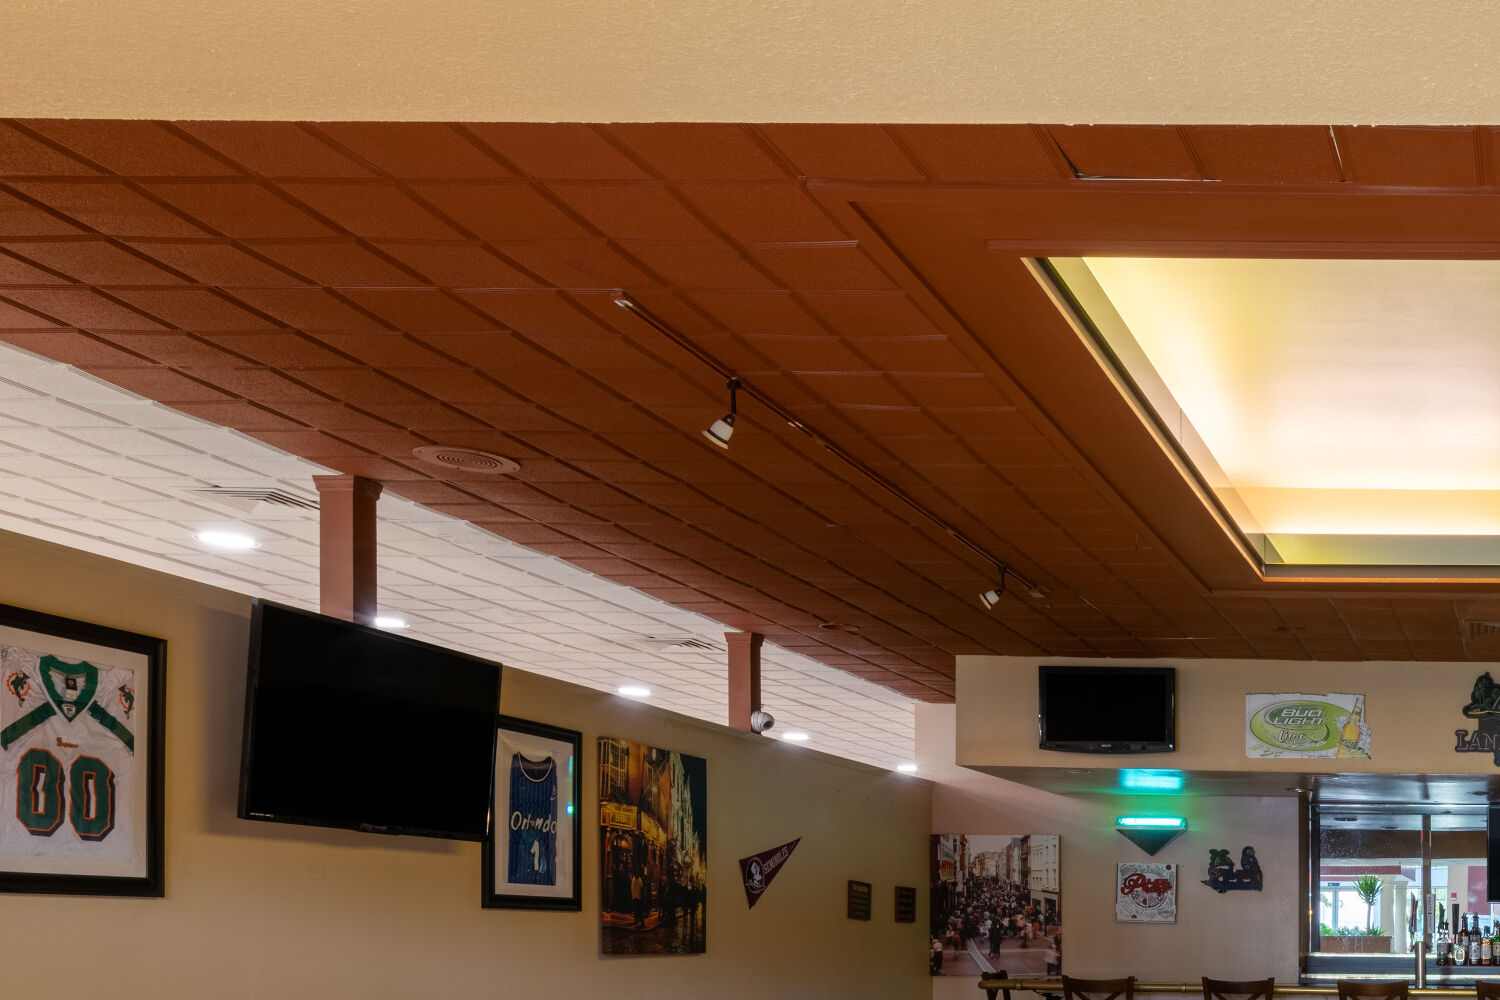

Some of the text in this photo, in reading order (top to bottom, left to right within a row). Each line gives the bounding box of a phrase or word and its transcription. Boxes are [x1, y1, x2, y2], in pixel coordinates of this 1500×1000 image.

[1281, 709, 1323, 718] BUD
[1272, 717, 1327, 726] LIGHT
[1278, 730, 1307, 744] Lime
[16, 748, 117, 843] 00
[530, 839, 540, 871] 1
